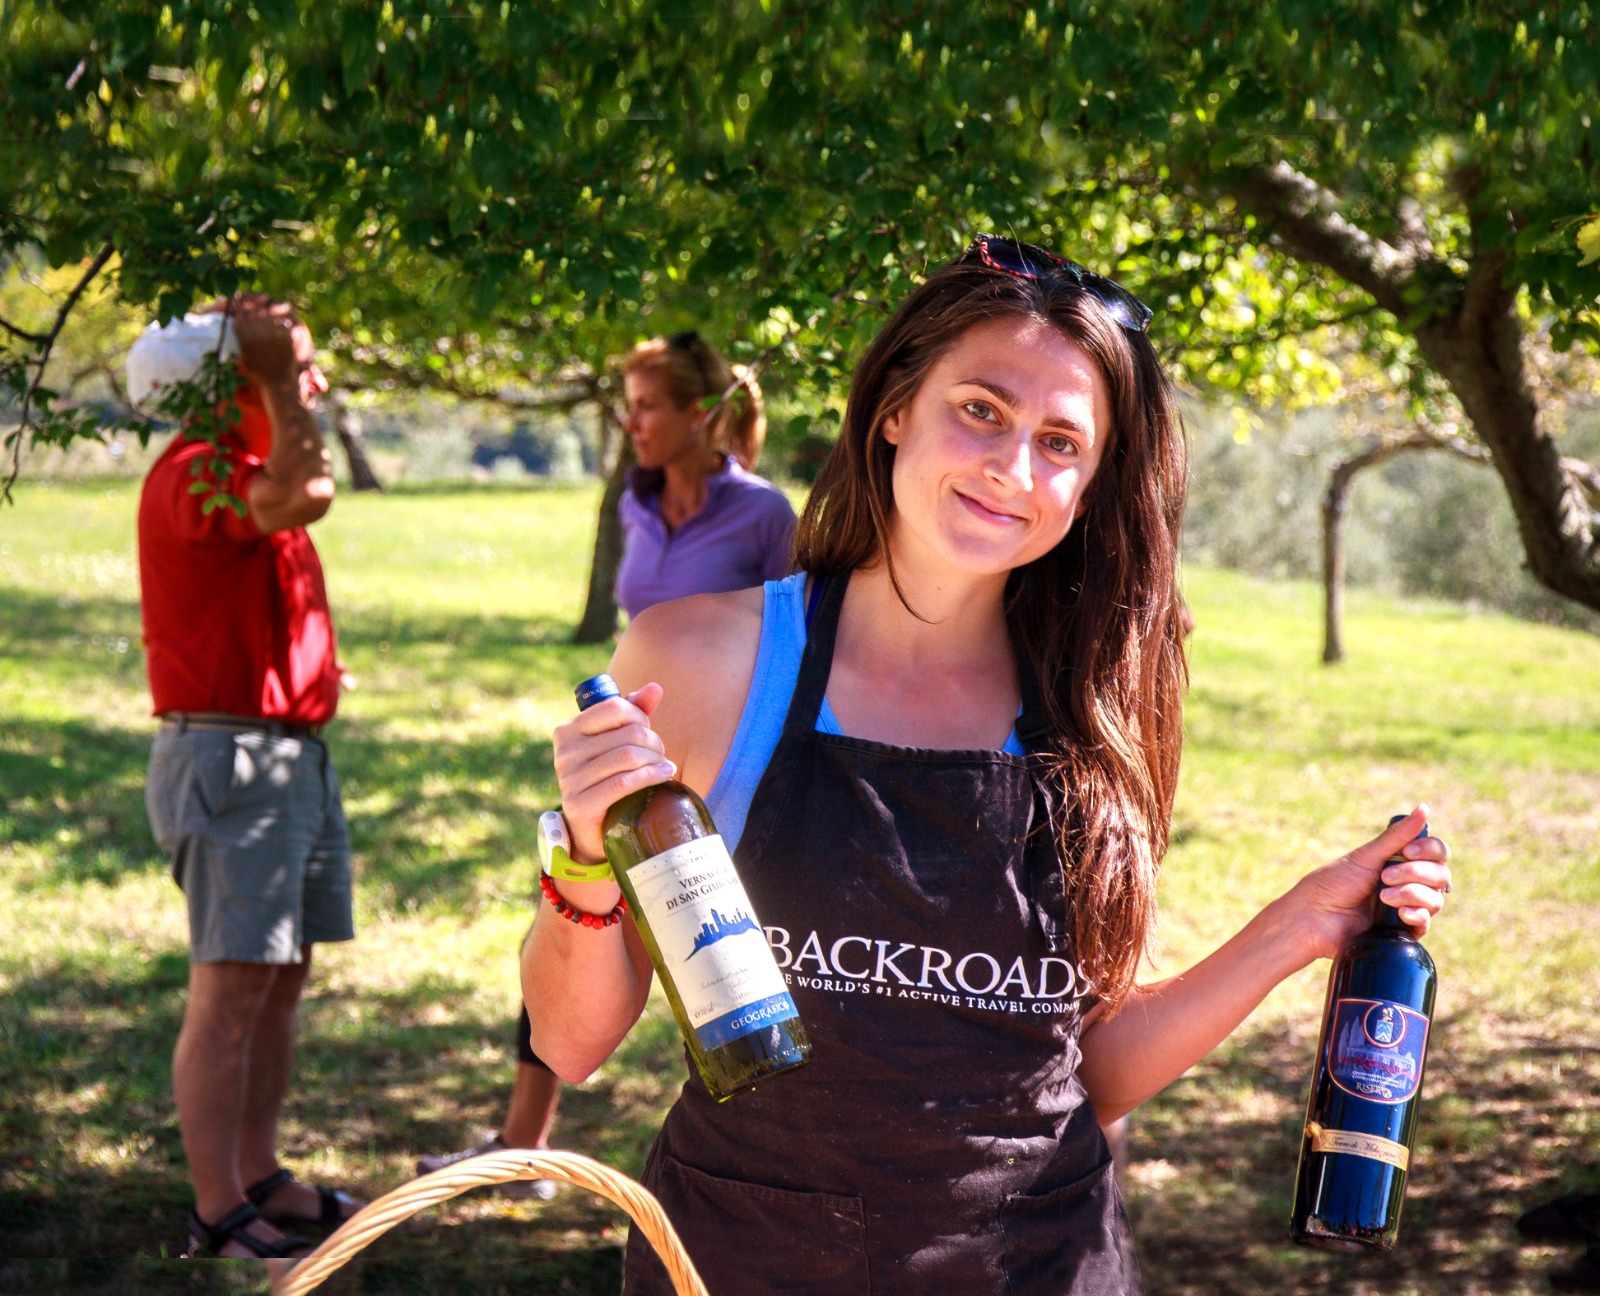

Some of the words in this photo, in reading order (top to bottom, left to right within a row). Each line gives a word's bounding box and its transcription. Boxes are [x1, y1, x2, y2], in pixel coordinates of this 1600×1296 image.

[666, 898, 678, 910] DI
[679, 889, 700, 904] SAN
[763, 926, 1091, 998] BACKROADS
[797, 976, 871, 995] WORLD'S
[876, 986, 892, 998] #1
[898, 989, 961, 1007] ACTIVE
[966, 997, 1027, 1013] TRAVEL
